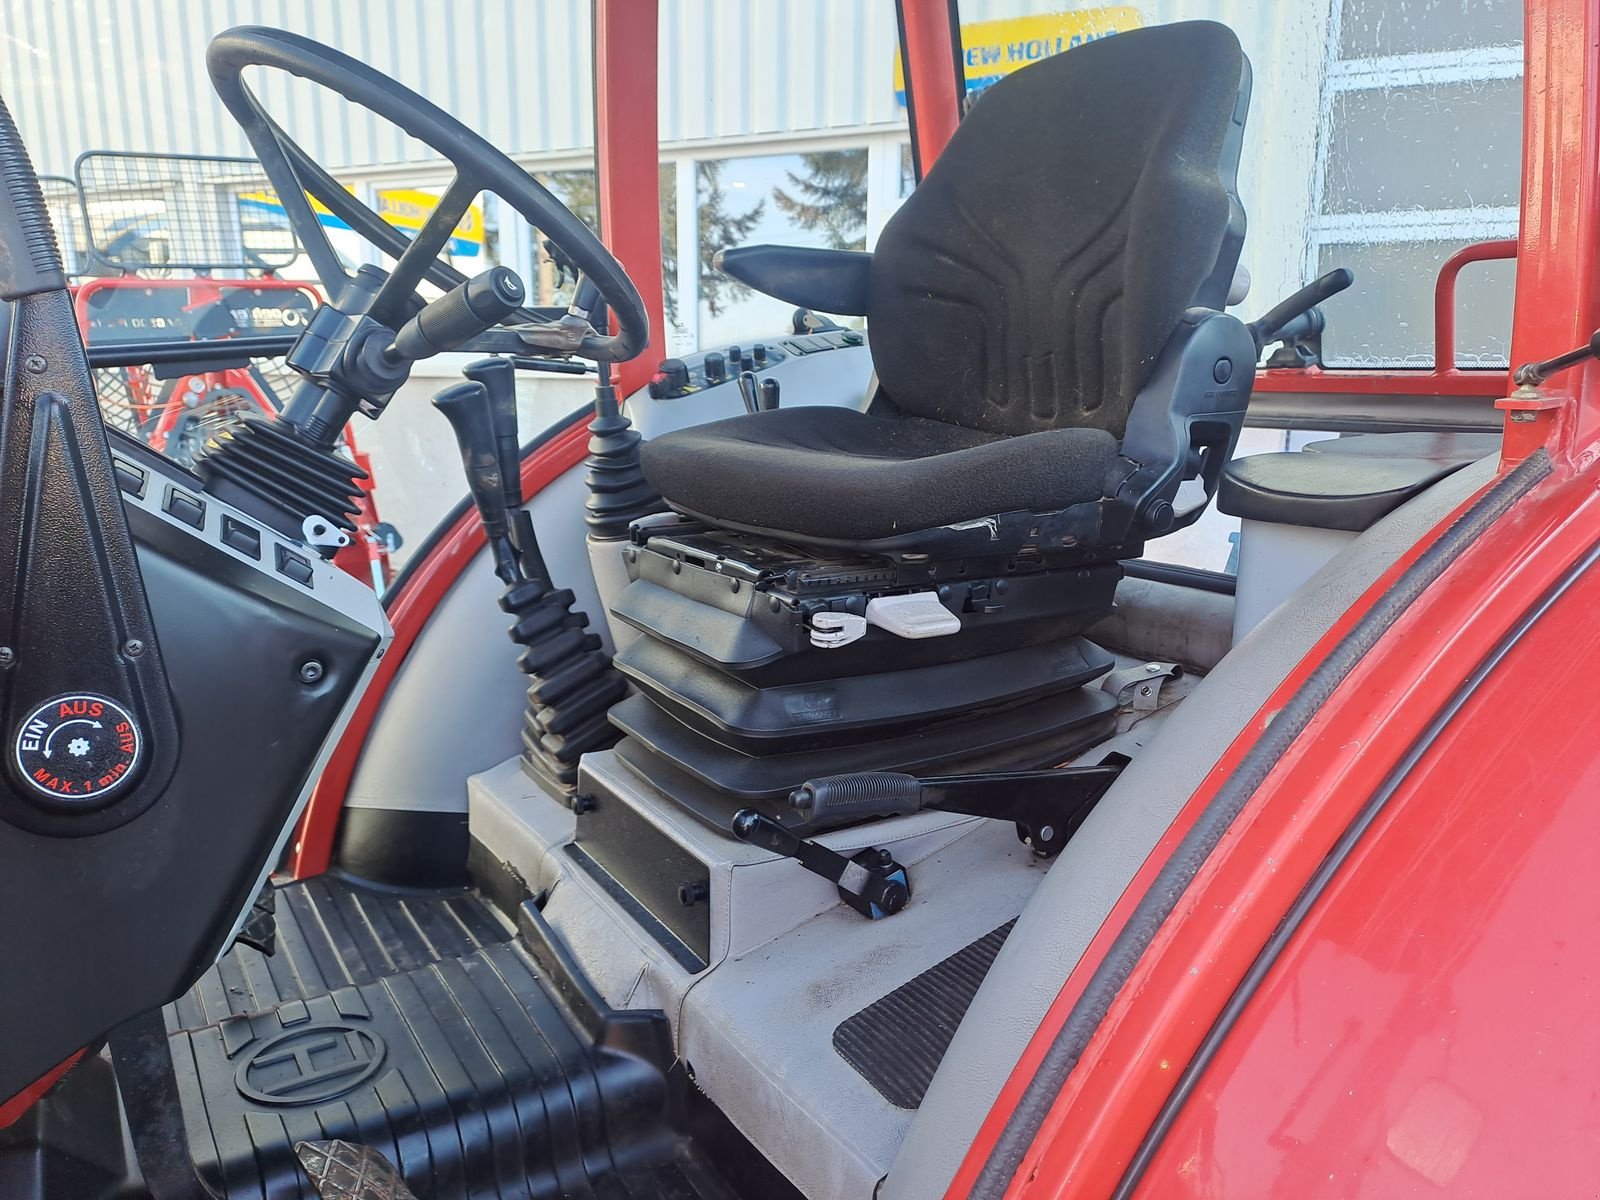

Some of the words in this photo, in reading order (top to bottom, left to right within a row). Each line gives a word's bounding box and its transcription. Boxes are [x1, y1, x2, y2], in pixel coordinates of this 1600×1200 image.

[963, 47, 1001, 66] EW
[59, 701, 104, 718] AUS
[22, 719, 48, 751] EIN
[33, 768, 79, 793] MAX.
[84, 780, 93, 792] 1
[98, 761, 129, 787] min.
[116, 722, 135, 753] AUS
